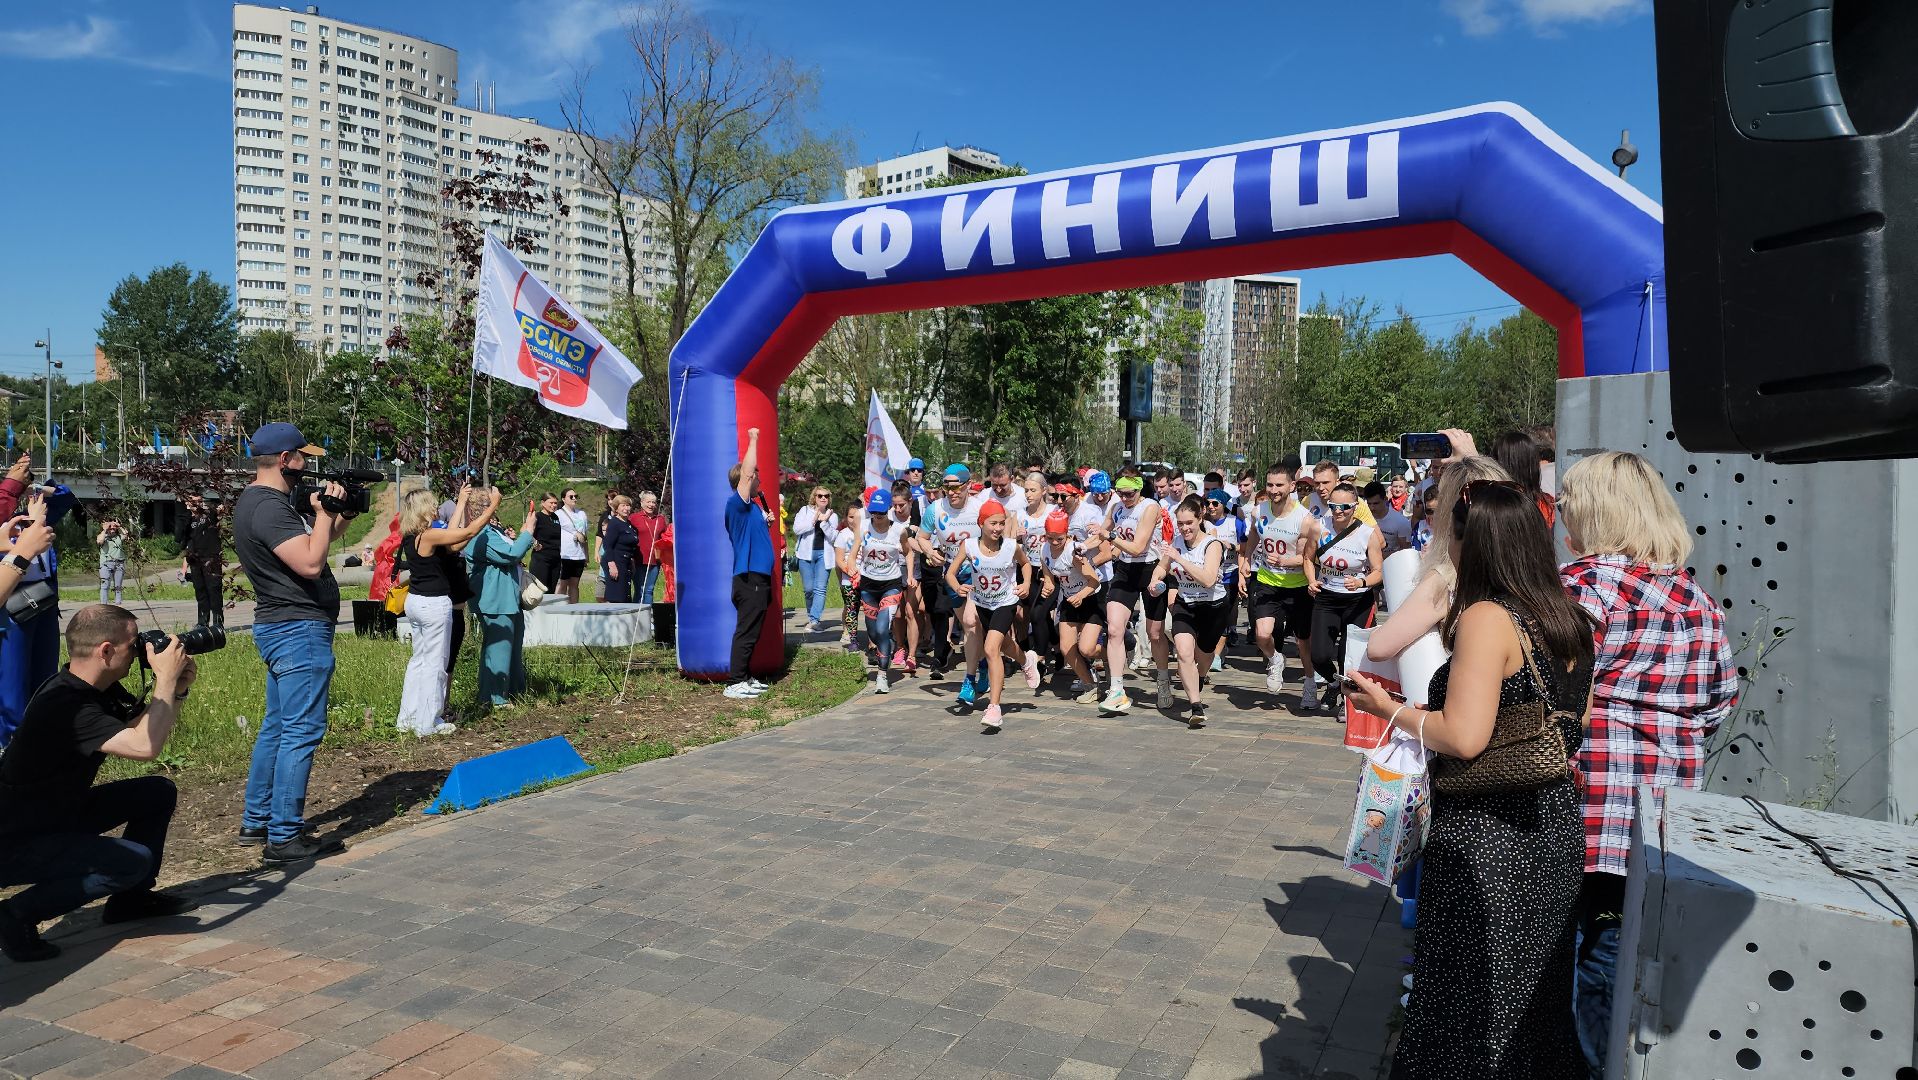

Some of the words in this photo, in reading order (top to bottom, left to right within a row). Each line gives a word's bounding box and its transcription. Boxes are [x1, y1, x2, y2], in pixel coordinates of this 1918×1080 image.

[831, 130, 1400, 279] ФИНИШ
[520, 315, 586, 362] БСМЭ
[867, 549, 889, 562] 43
[1264, 537, 1287, 556] 60
[1323, 555, 1348, 572] 49
[978, 575, 1002, 592] 95
